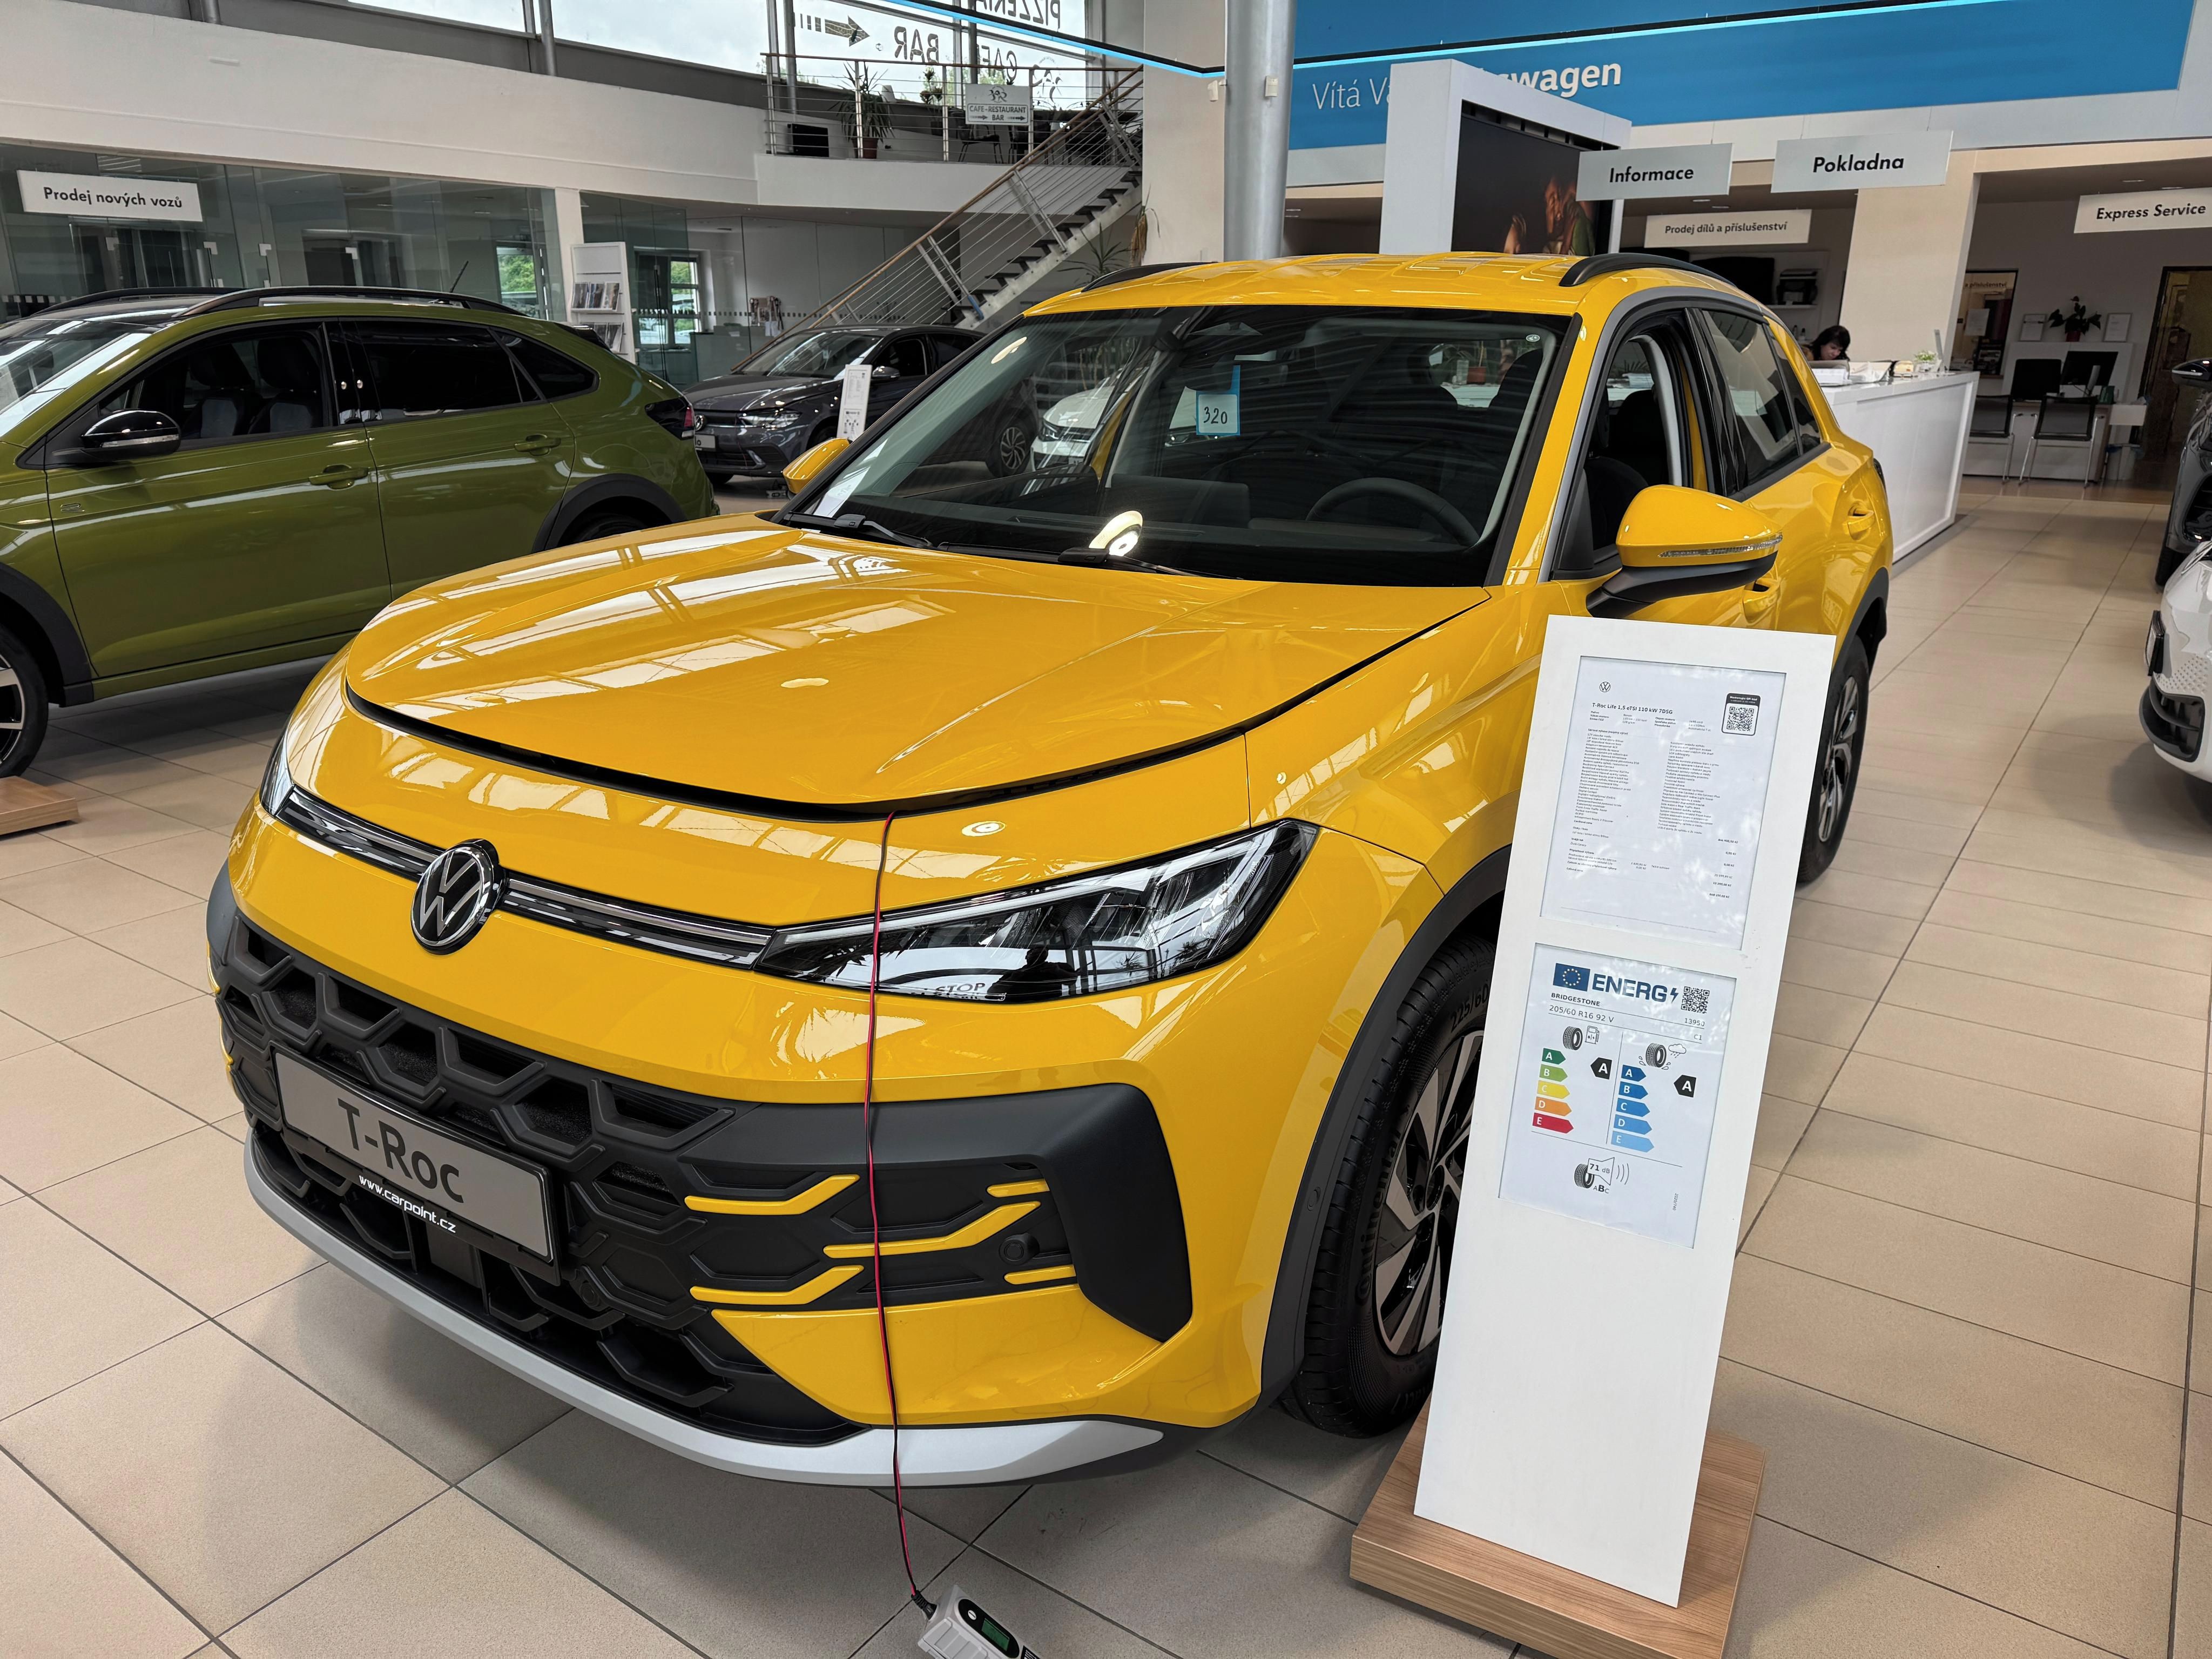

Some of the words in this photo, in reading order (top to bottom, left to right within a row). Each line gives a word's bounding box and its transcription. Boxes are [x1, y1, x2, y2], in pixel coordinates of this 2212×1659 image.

[1312, 79, 1360, 110] Vítá
[1498, 63, 1621, 98] wagen
[1813, 153, 1904, 173] Pokladna
[1609, 166, 1694, 183] Informace
[43, 187, 92, 205] Prodej
[96, 193, 146, 207] nových
[150, 196, 183, 208] vozů
[2096, 207, 2149, 221] Express
[2153, 203, 2206, 217] Service
[1664, 225, 1695, 235] Prodej
[1697, 224, 1715, 233] dílů
[1724, 221, 1788, 234] příslušenství
[1203, 406, 1228, 424] 320
[1592, 973, 1668, 1003] ENERG
[1551, 993, 1601, 1007] BRIDGESTONE
[1549, 1004, 1576, 1016] 205/60
[1577, 1011, 1594, 1020] R16
[1596, 1014, 1606, 1022] 92
[1546, 1052, 1553, 1061] A
[1599, 1063, 1608, 1074] A
[1626, 1069, 1633, 1077] A
[1624, 1085, 1630, 1094] B
[1682, 1081, 1691, 1091] A
[1537, 1117, 1542, 1125] E
[1616, 1135, 1622, 1143] E
[338, 1098, 464, 1203] T-Roc
[1589, 1163, 1600, 1171] 71
[359, 1175, 456, 1233] www.carpoint.cz
